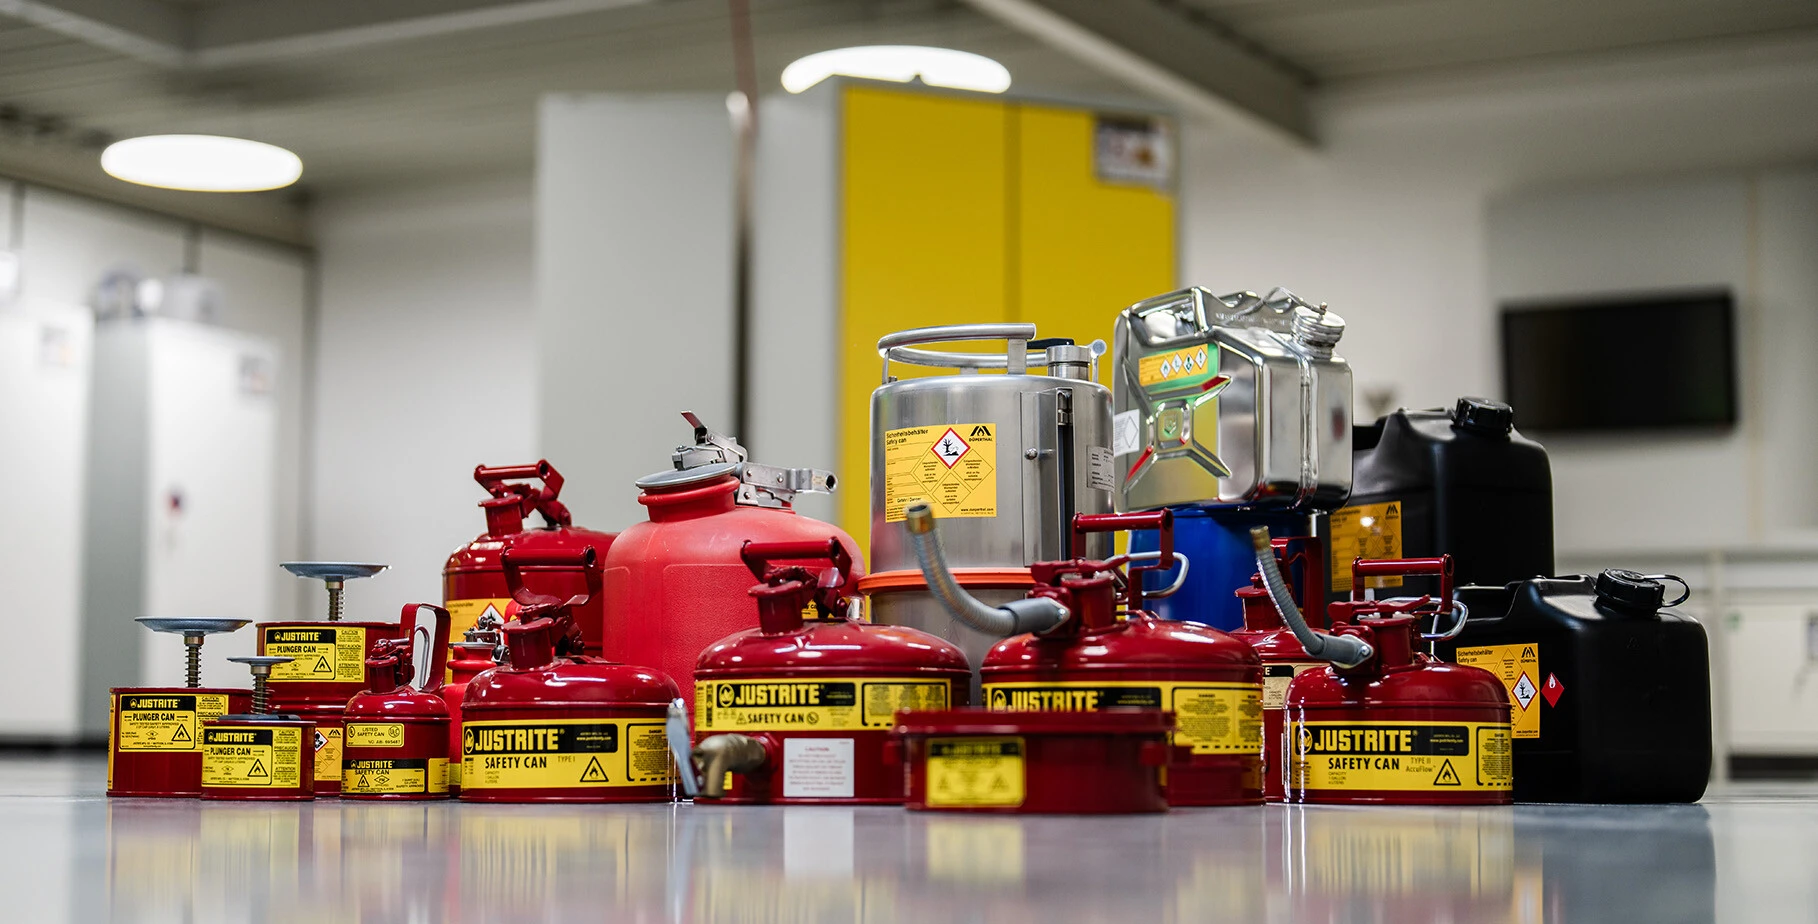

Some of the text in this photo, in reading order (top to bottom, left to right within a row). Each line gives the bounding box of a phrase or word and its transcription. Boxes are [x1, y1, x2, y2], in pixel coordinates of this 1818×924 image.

[280, 631, 320, 641] JUSTRITE
[276, 645, 317, 653] PLUNGER CAN
[735, 684, 820, 705] JUSTRITE
[137, 698, 178, 709] JUSTRITE
[1007, 690, 1099, 713] JUSTRITE
[132, 713, 175, 721] PLUNGER CAN
[747, 712, 805, 724] SAFETY CAN
[213, 732, 255, 743] JUSTRITE
[475, 728, 559, 751] JUSTRITE
[1314, 729, 1412, 752] JUSTRITE
[209, 747, 251, 756] PLUNGER CAN
[356, 760, 393, 769] JUSTRITE
[485, 756, 547, 769] SAFETY CAN
[557, 755, 572, 763] TYPE
[1328, 757, 1400, 770] SAFETY CAN
